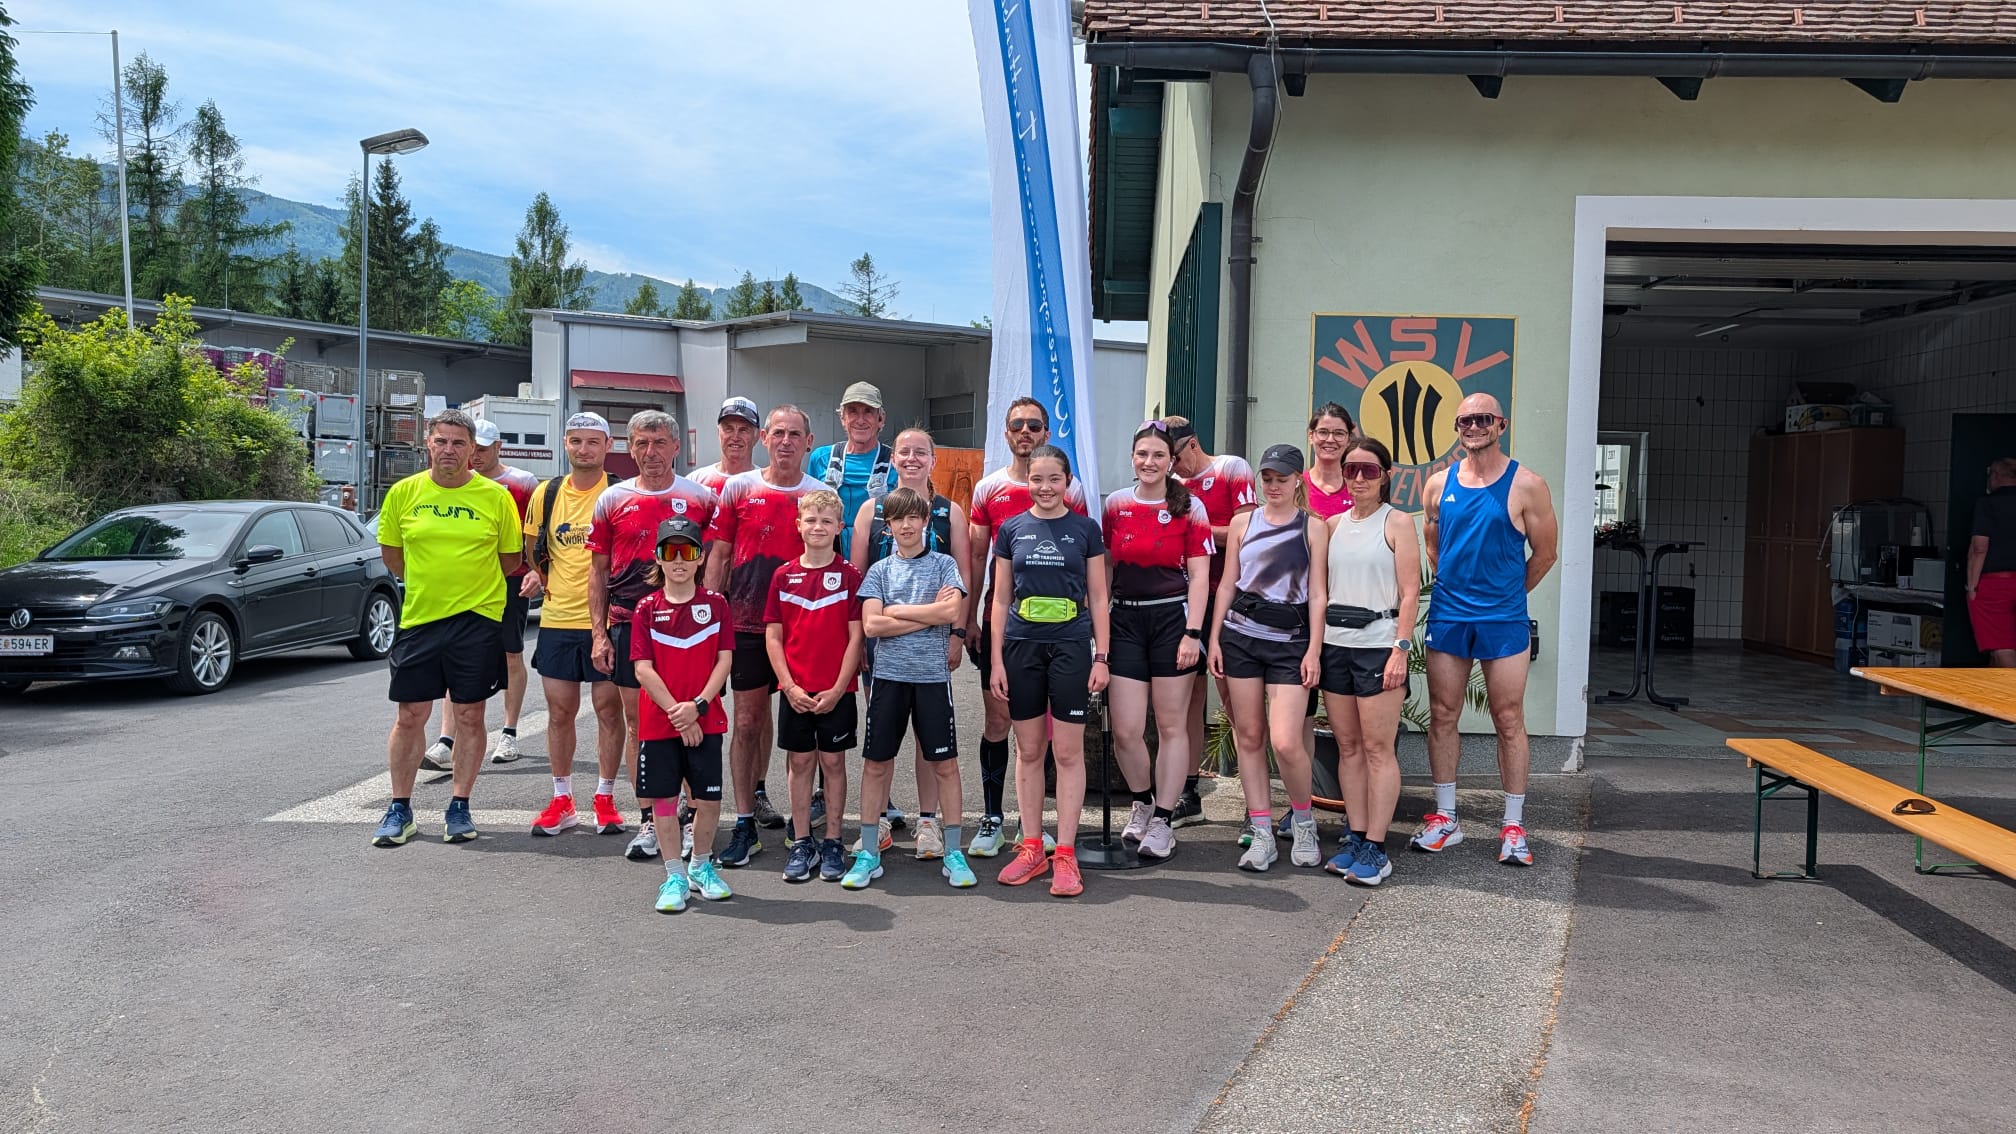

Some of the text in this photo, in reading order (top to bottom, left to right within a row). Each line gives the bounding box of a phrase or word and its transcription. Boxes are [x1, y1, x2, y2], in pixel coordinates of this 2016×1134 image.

[1317, 318, 1510, 389] WSV
[565, 534, 586, 545] WORL
[11, 638, 32, 650] 594
[34, 638, 49, 650] ER
